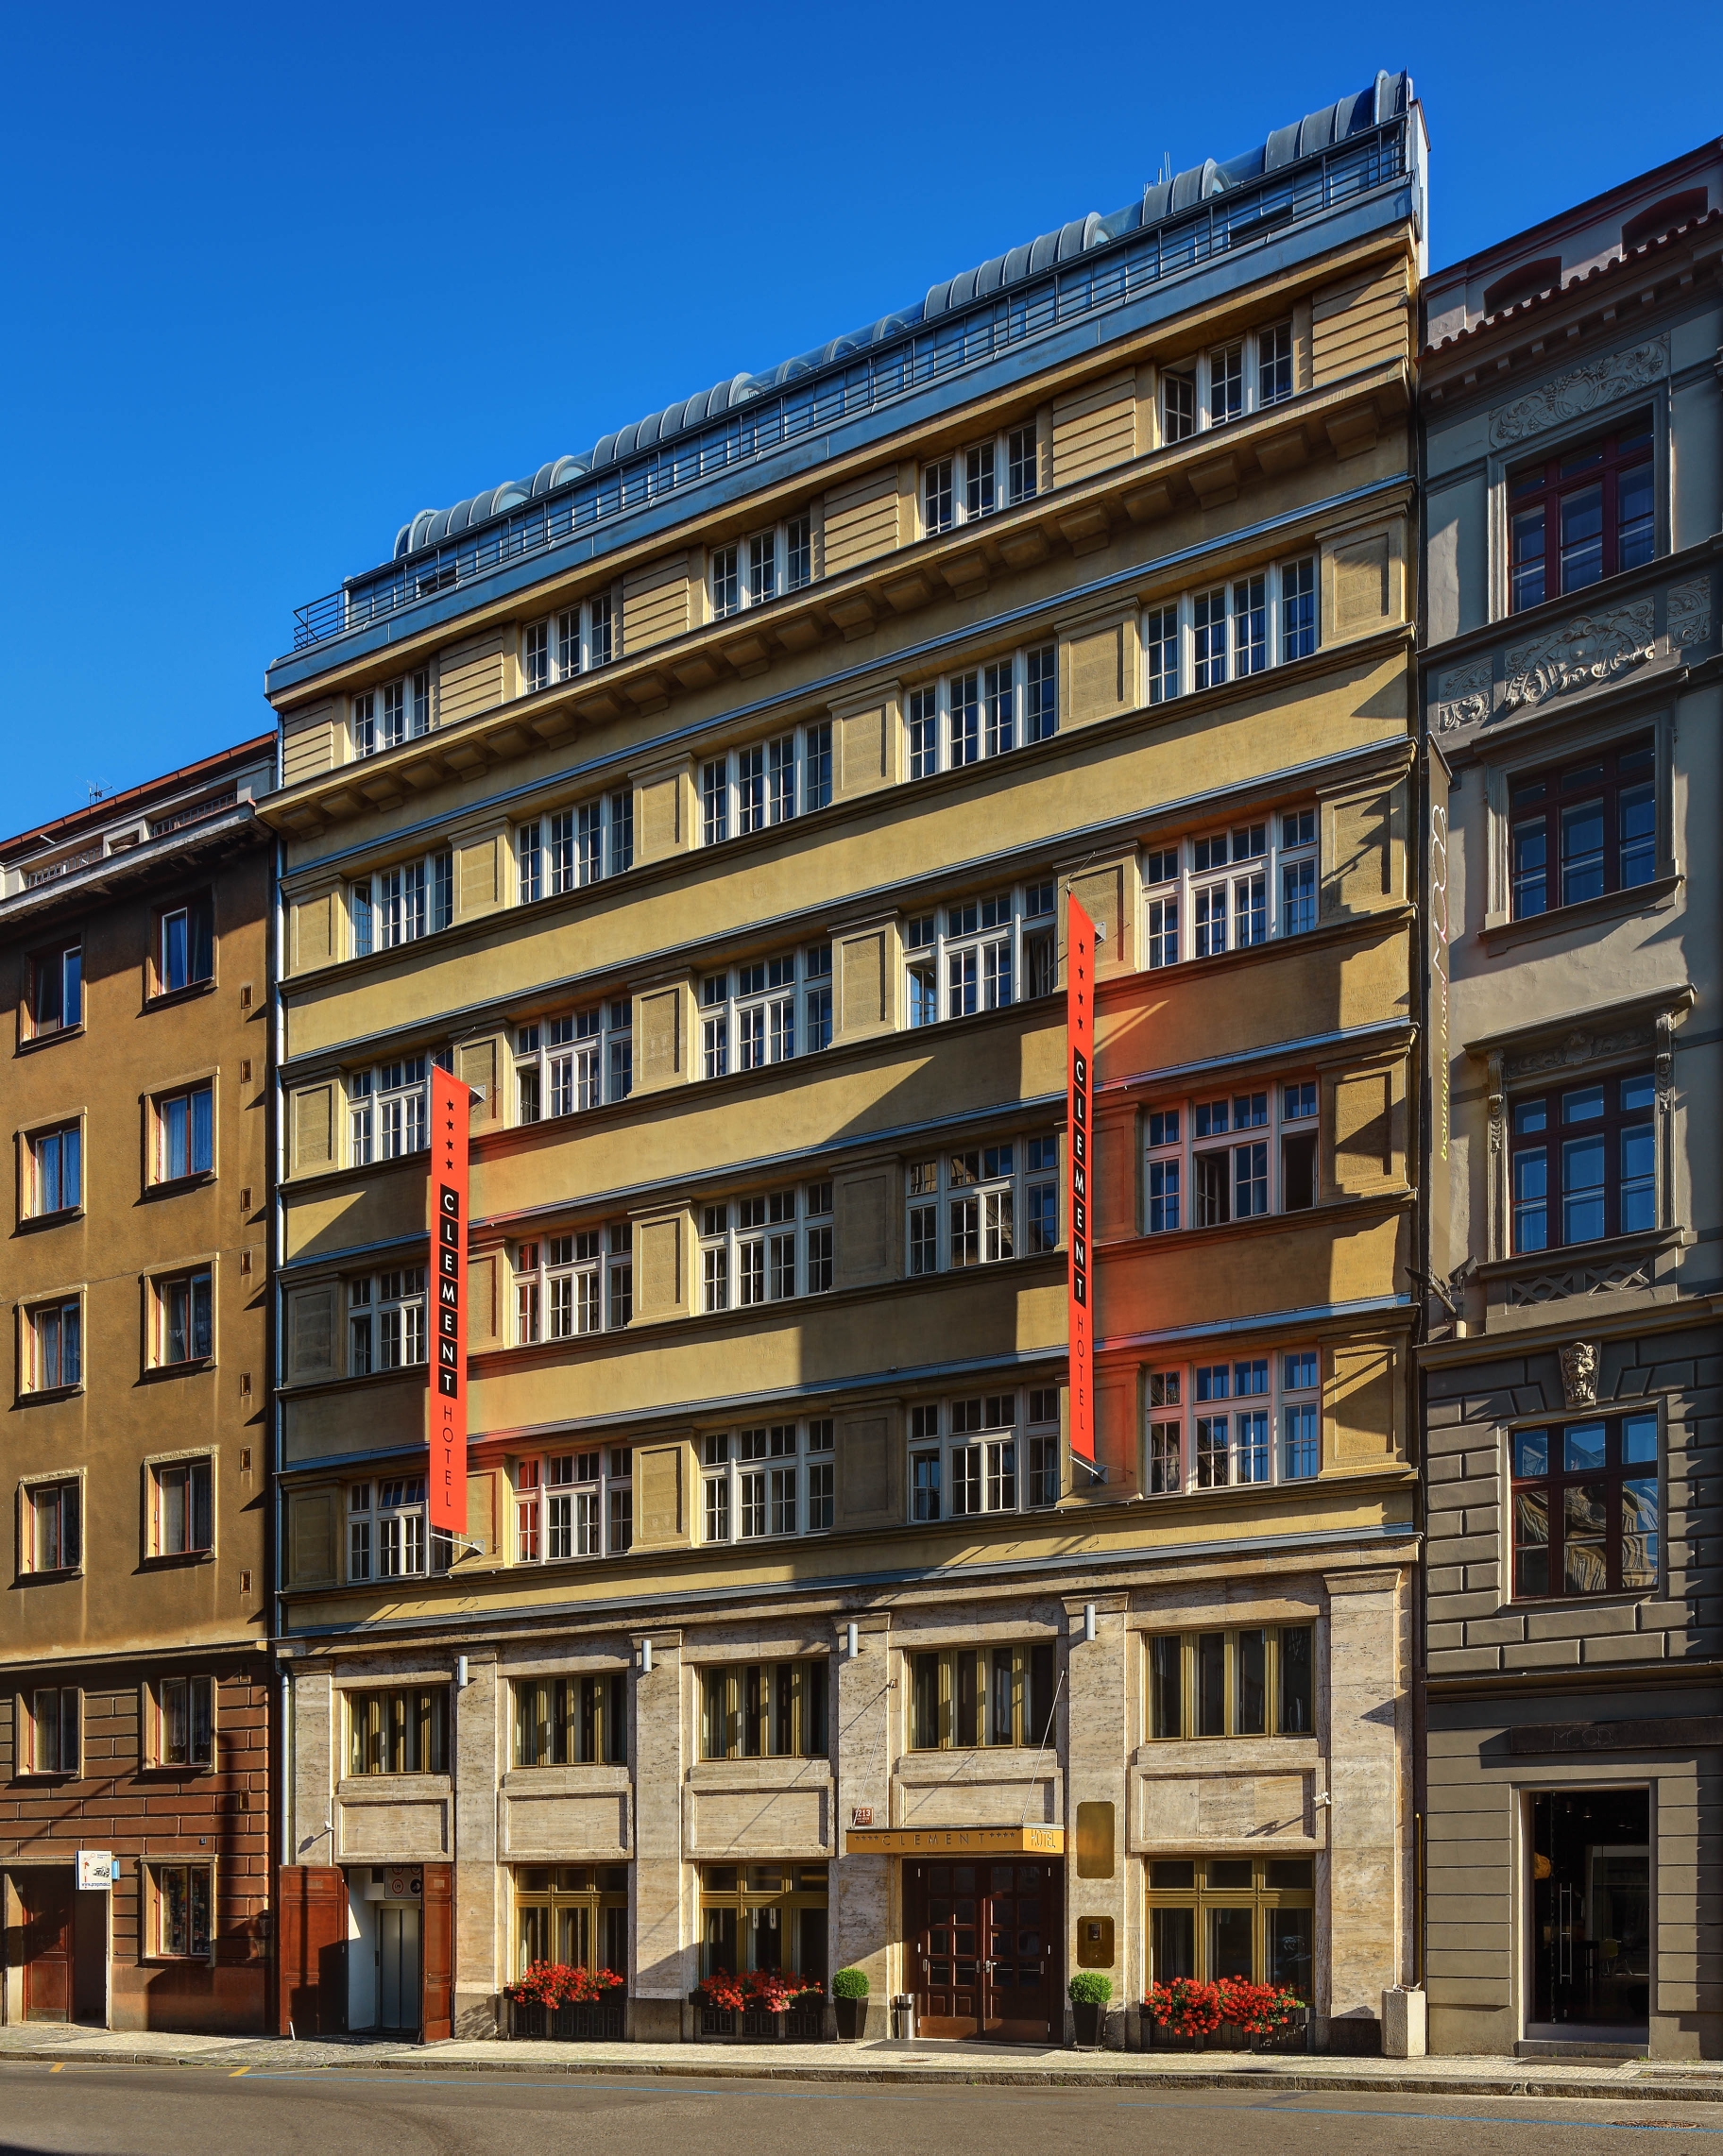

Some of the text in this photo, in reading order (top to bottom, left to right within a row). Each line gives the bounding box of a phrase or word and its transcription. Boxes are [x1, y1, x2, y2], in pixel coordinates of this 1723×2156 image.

[1441, 1047, 1449, 1162] boutique
[1074, 1060, 1084, 1299] CLEMENT
[441, 1194, 455, 1507] CLEMENT HOTEL
[882, 1832, 984, 1846] CLEMENT
[1030, 1829, 1056, 1848] HOTEL
